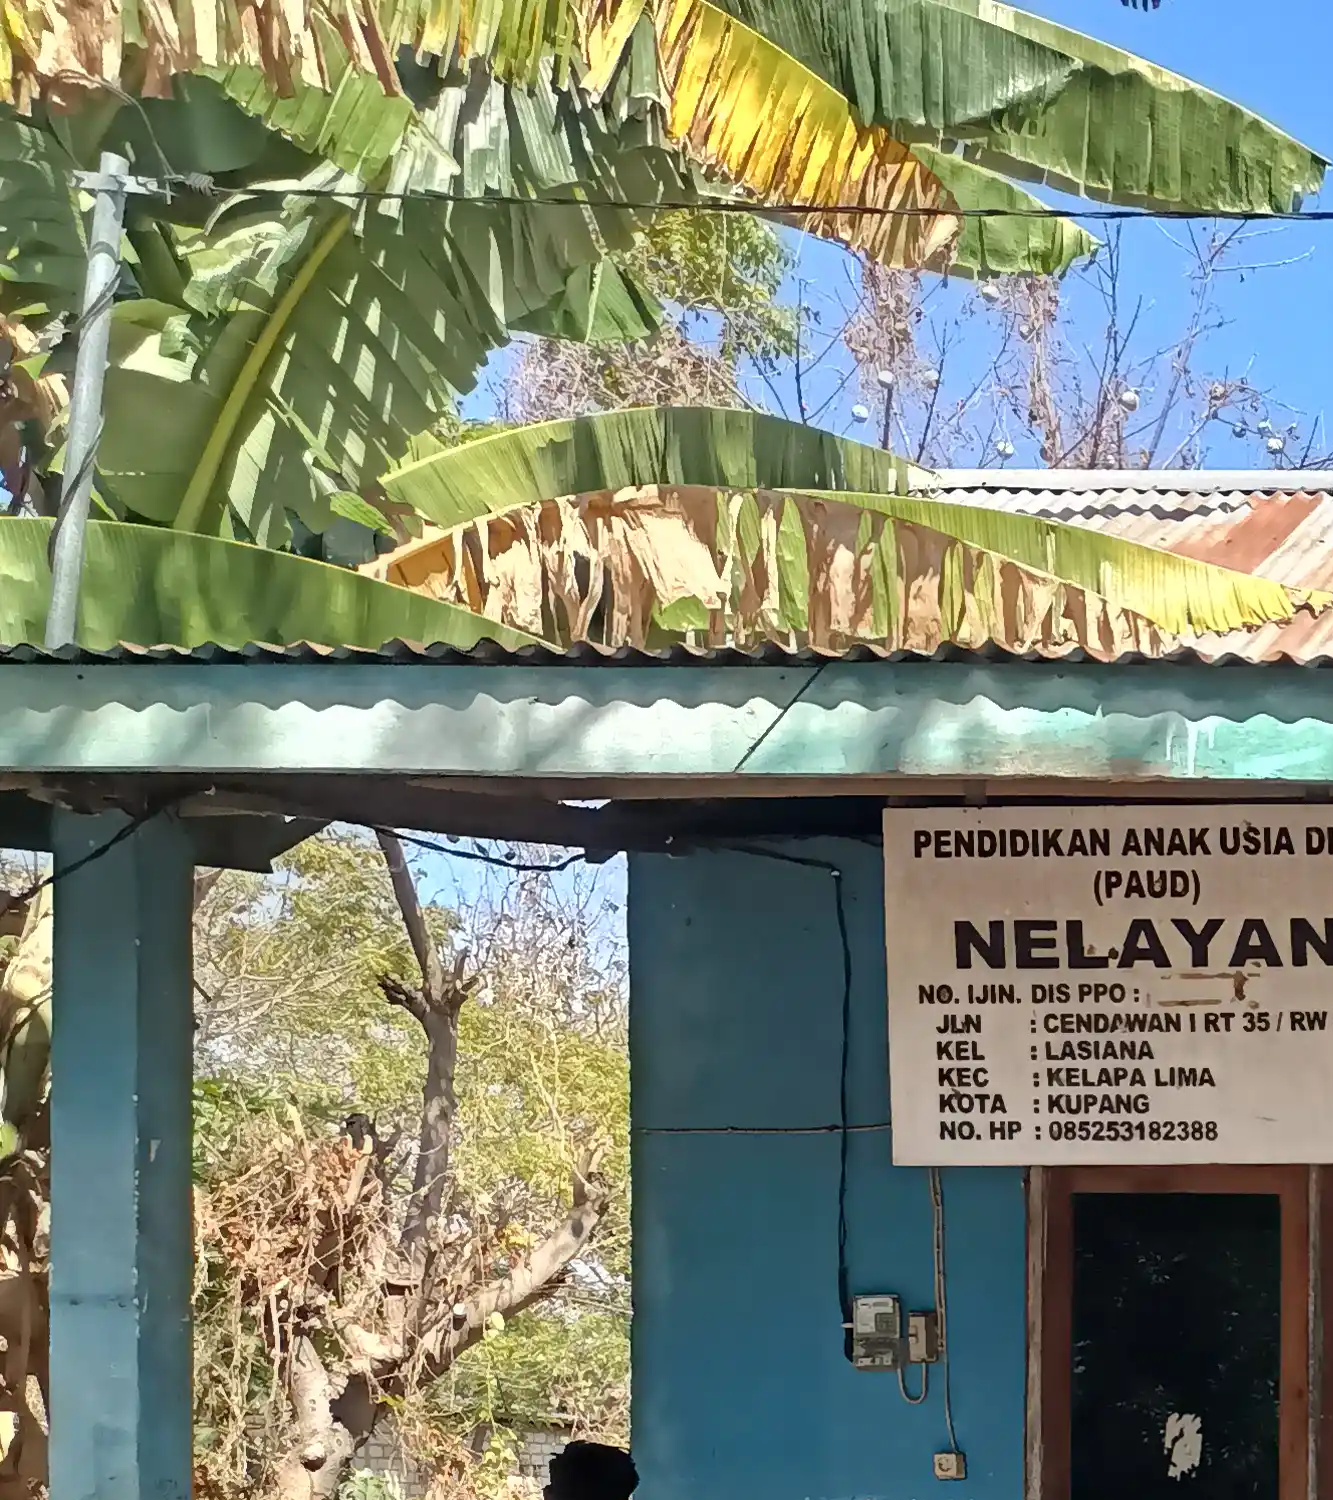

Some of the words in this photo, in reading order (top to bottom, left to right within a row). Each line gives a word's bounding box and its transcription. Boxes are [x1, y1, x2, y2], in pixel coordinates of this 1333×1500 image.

[914, 829, 1110, 858] PENDIDIKAN
[1121, 827, 1212, 857] ANAK
[1219, 826, 1295, 855] USIA
[1093, 869, 1201, 906] (PAUD)
[918, 984, 960, 1004] NO.
[1031, 984, 1071, 1003] DIS
[1078, 983, 1126, 1003] PPO
[936, 1014, 982, 1034] JLN
[1043, 1012, 1181, 1034] CENDAWAN
[1204, 1012, 1235, 1033] RT
[1242, 1012, 1271, 1032] 35
[1276, 1012, 1283, 1032] /
[1289, 1011, 1328, 1031] RW
[936, 1041, 985, 1061] KEL
[1045, 1041, 1154, 1060] LASIANA
[938, 1067, 989, 1088] KEC
[1046, 1067, 1146, 1087] KELAPA
[1154, 1066, 1216, 1087] LIMA
[938, 1093, 1007, 1114] KOTA
[1047, 1093, 1150, 1114] KUPANG
[939, 1121, 982, 1140] NO.
[989, 1121, 1022, 1140] HP
[1049, 1120, 1219, 1141] 085253182388
